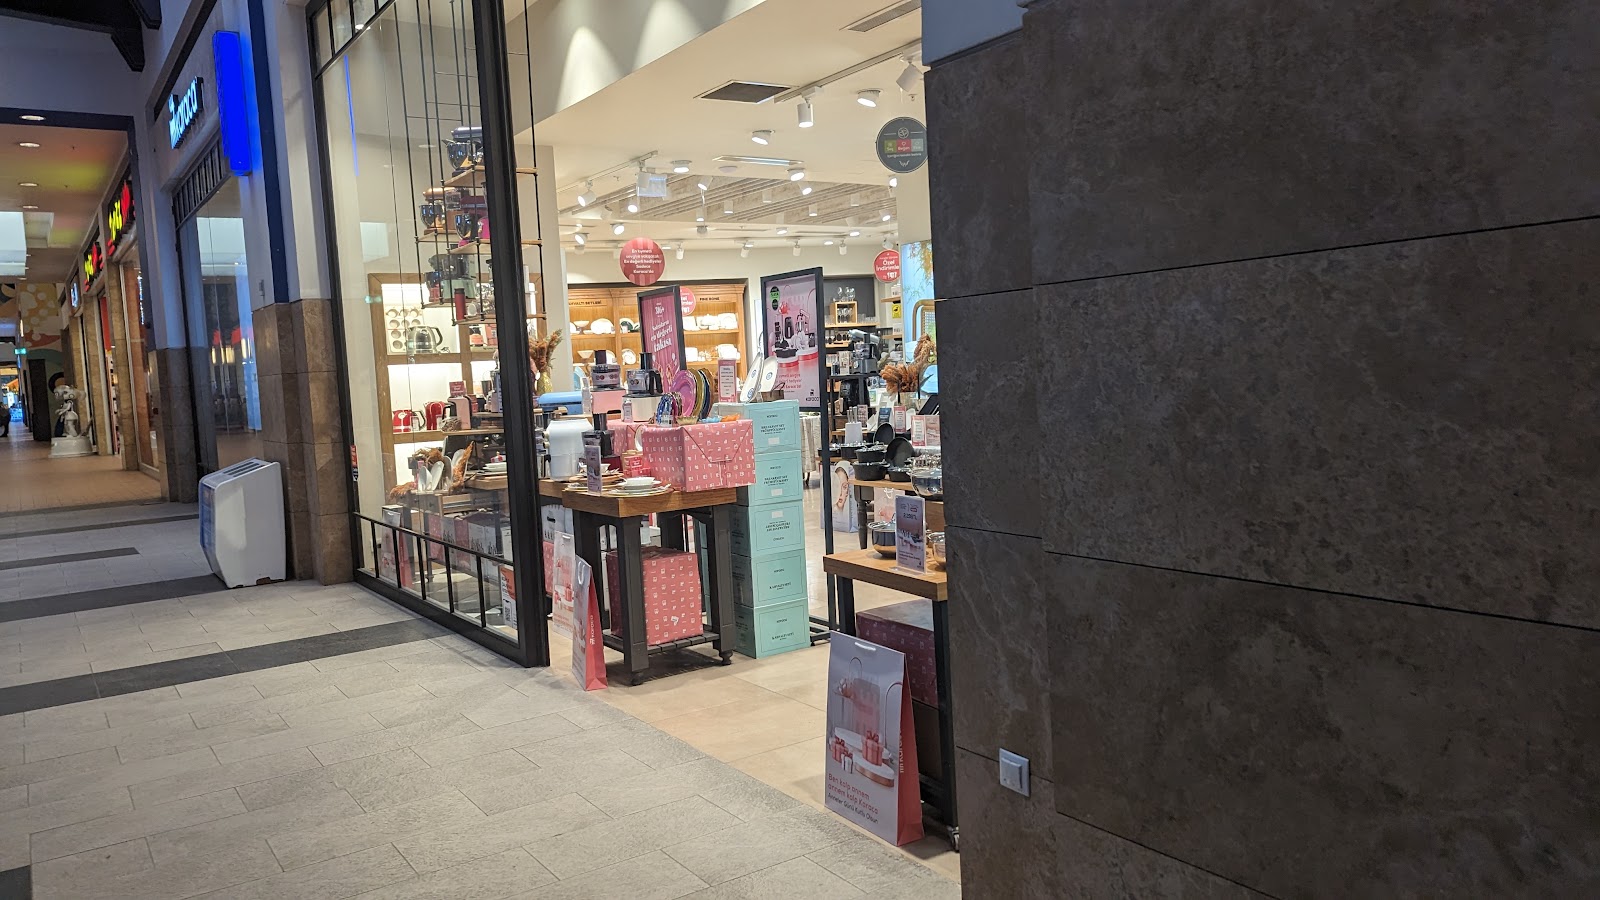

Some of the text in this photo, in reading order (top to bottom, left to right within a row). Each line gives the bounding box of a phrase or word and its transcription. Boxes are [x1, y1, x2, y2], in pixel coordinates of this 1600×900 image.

[828, 773, 870, 800] Ben kalp annem
[828, 784, 879, 815] annem kalp Karaca
[828, 792, 879, 824] Anneler Günü Kutlu Olsun
